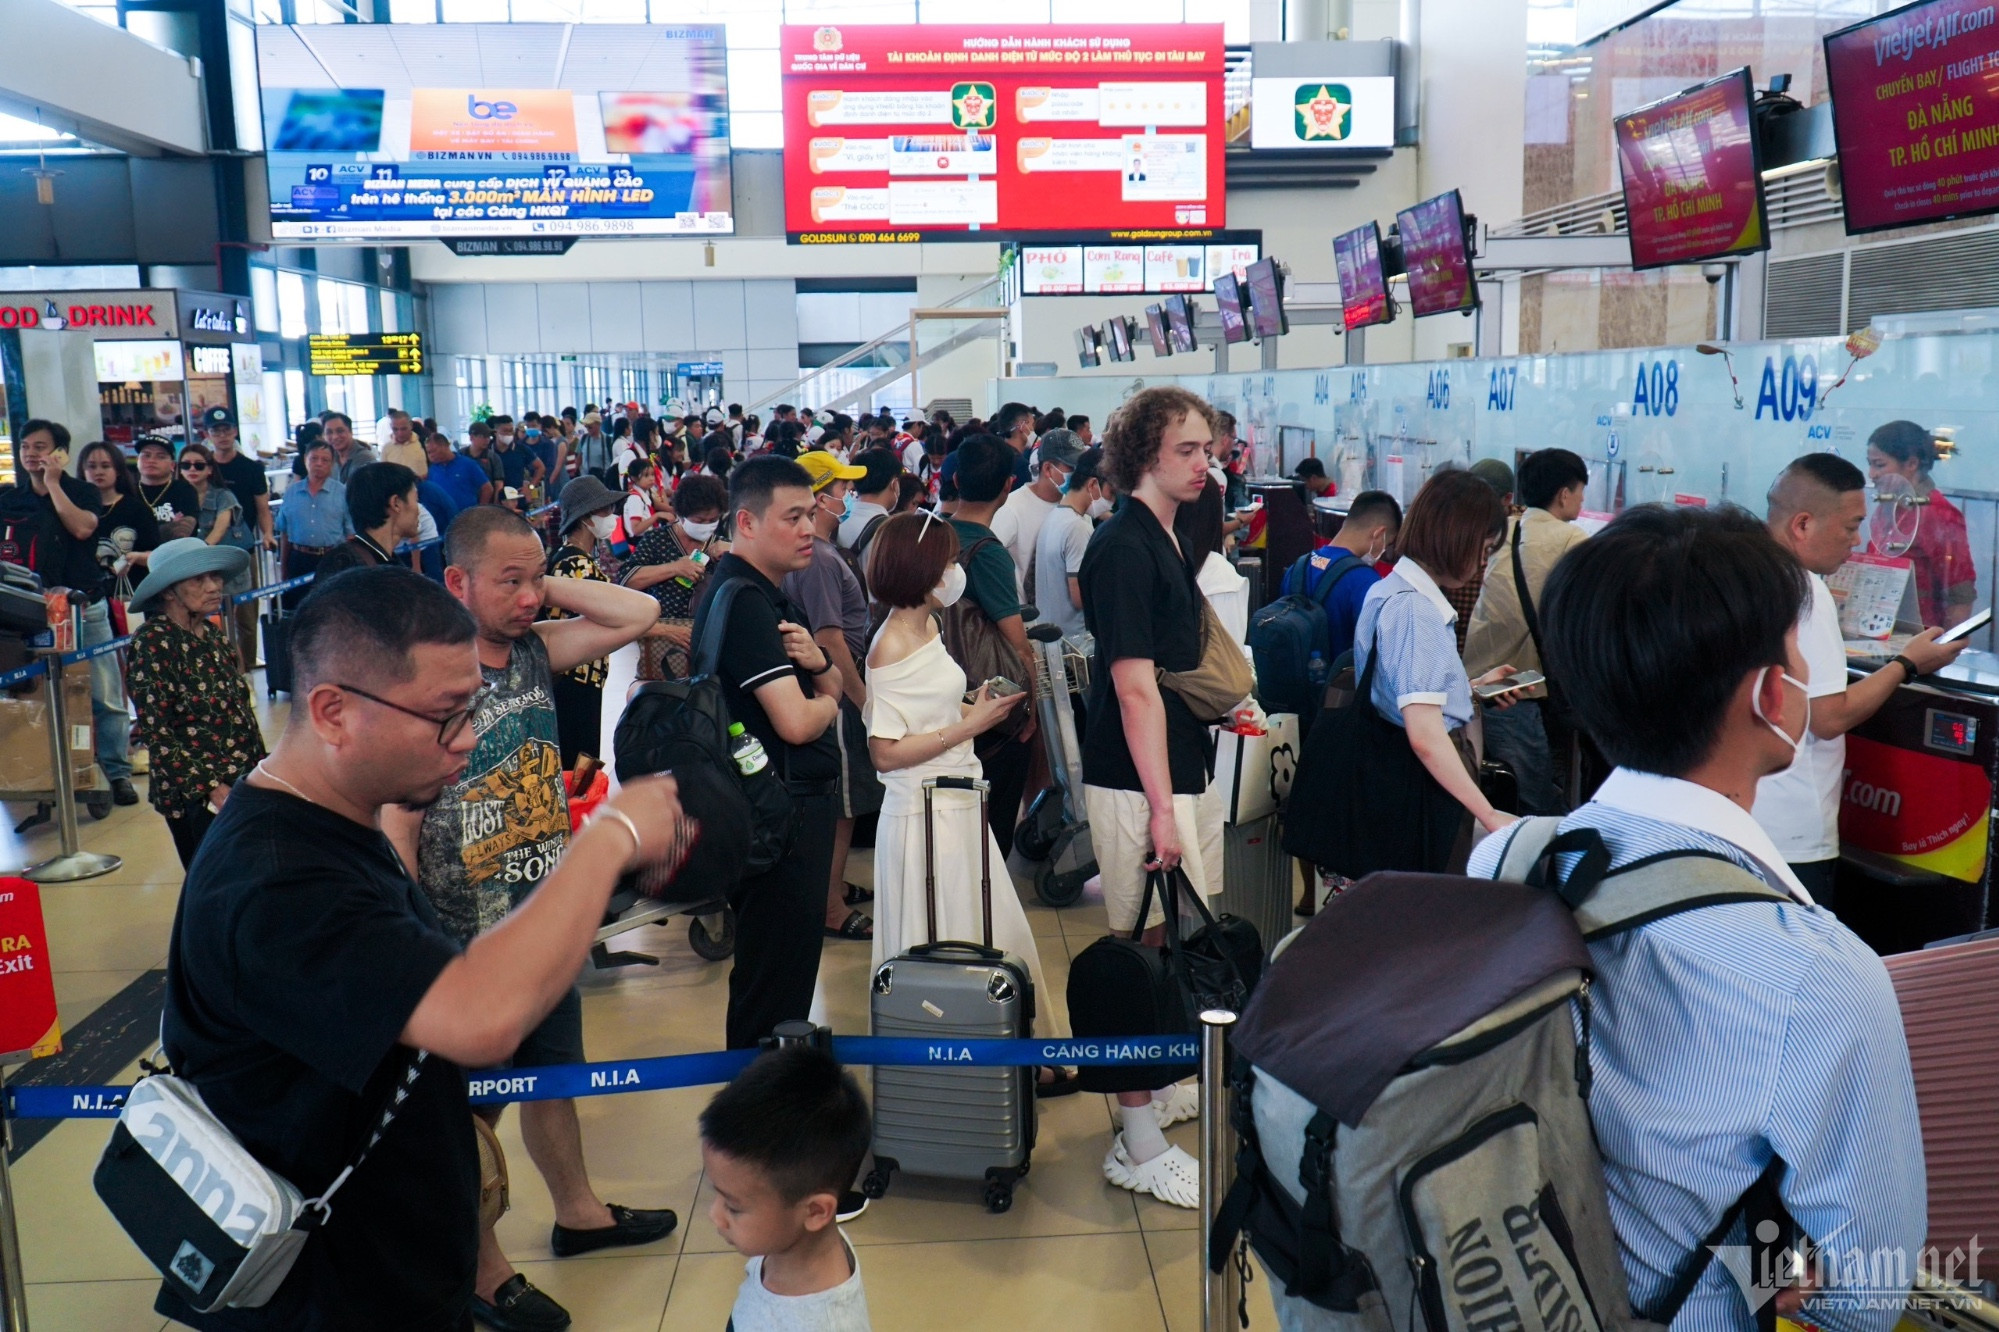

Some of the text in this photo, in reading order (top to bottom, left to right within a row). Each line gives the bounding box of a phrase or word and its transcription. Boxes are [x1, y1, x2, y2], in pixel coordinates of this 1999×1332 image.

[666, 30, 715, 39] BIZMAN
[1024, 37, 1051, 48] HÀNH
[1053, 37, 1087, 48] KHÁCH
[1103, 38, 1130, 49] DỤNG
[970, 52, 999, 62] DANH
[1082, 52, 1089, 61] 2
[1091, 50, 1111, 61] LÀM
[1187, 51, 1205, 61] BAY
[1875, 72, 1914, 101] CHUYẾN
[1947, 57, 1985, 80] FLIGHT
[467, 94, 518, 120] be
[1907, 93, 1974, 131] ĐÀ NẴNG
[1889, 147, 1908, 167] TP.
[1911, 134, 1931, 163] HỒ
[1934, 128, 1959, 157] CHÍ
[309, 168, 329, 181] 10
[339, 165, 364, 173] ACV
[376, 169, 392, 180] 11
[576, 166, 601, 174] ACV
[444, 181, 475, 190] cung
[478, 177, 503, 189] cấp
[506, 178, 539, 189] DỊCH
[543, 177, 560, 189] VỤ
[1937, 177, 1946, 187] 40
[1946, 174, 1963, 189] phút
[351, 193, 379, 204] trên
[523, 188, 565, 202] MÀN
[571, 187, 616, 202] HÌNH
[623, 190, 653, 201] LED
[1933, 195, 1941, 205] 40
[1942, 191, 1959, 203] mins
[1959, 190, 1973, 202] prior
[1974, 189, 1981, 198] to
[434, 205, 569, 219] tại các Cảng HKQT
[1680, 198, 1695, 217] CHÍ
[1697, 193, 1722, 214] MINH
[550, 221, 634, 232] 094.986.9898
[800, 232, 920, 244] GOLDSUN 090 464 6699
[1111, 230, 1212, 240] www.goldsungroup.com.vn
[457, 242, 497, 251] BIZMAN
[1026, 249, 1067, 264] PHỞ
[1115, 250, 1141, 264] Rang
[1147, 250, 1173, 262] Café
[68, 305, 155, 327] DRINK
[194, 346, 231, 373] COFFEE
[1314, 375, 1329, 405] A04
[1427, 368, 1450, 410] A06
[1488, 367, 1517, 411] A07
[1632, 359, 1679, 416] A08
[1754, 354, 1817, 421] A09
[1597, 416, 1612, 426] ACV
[1808, 425, 1831, 439] ACV
[460, 800, 506, 847] LOST
[470, 833, 514, 863] ALWAYS
[1902, 840, 1917, 853] Bay
[1918, 838, 1927, 850] là
[1928, 829, 1949, 848] Thích
[504, 846, 532, 863] THE
[928, 1046, 972, 1062] N.I.A
[591, 1069, 640, 1089] N.I.A
